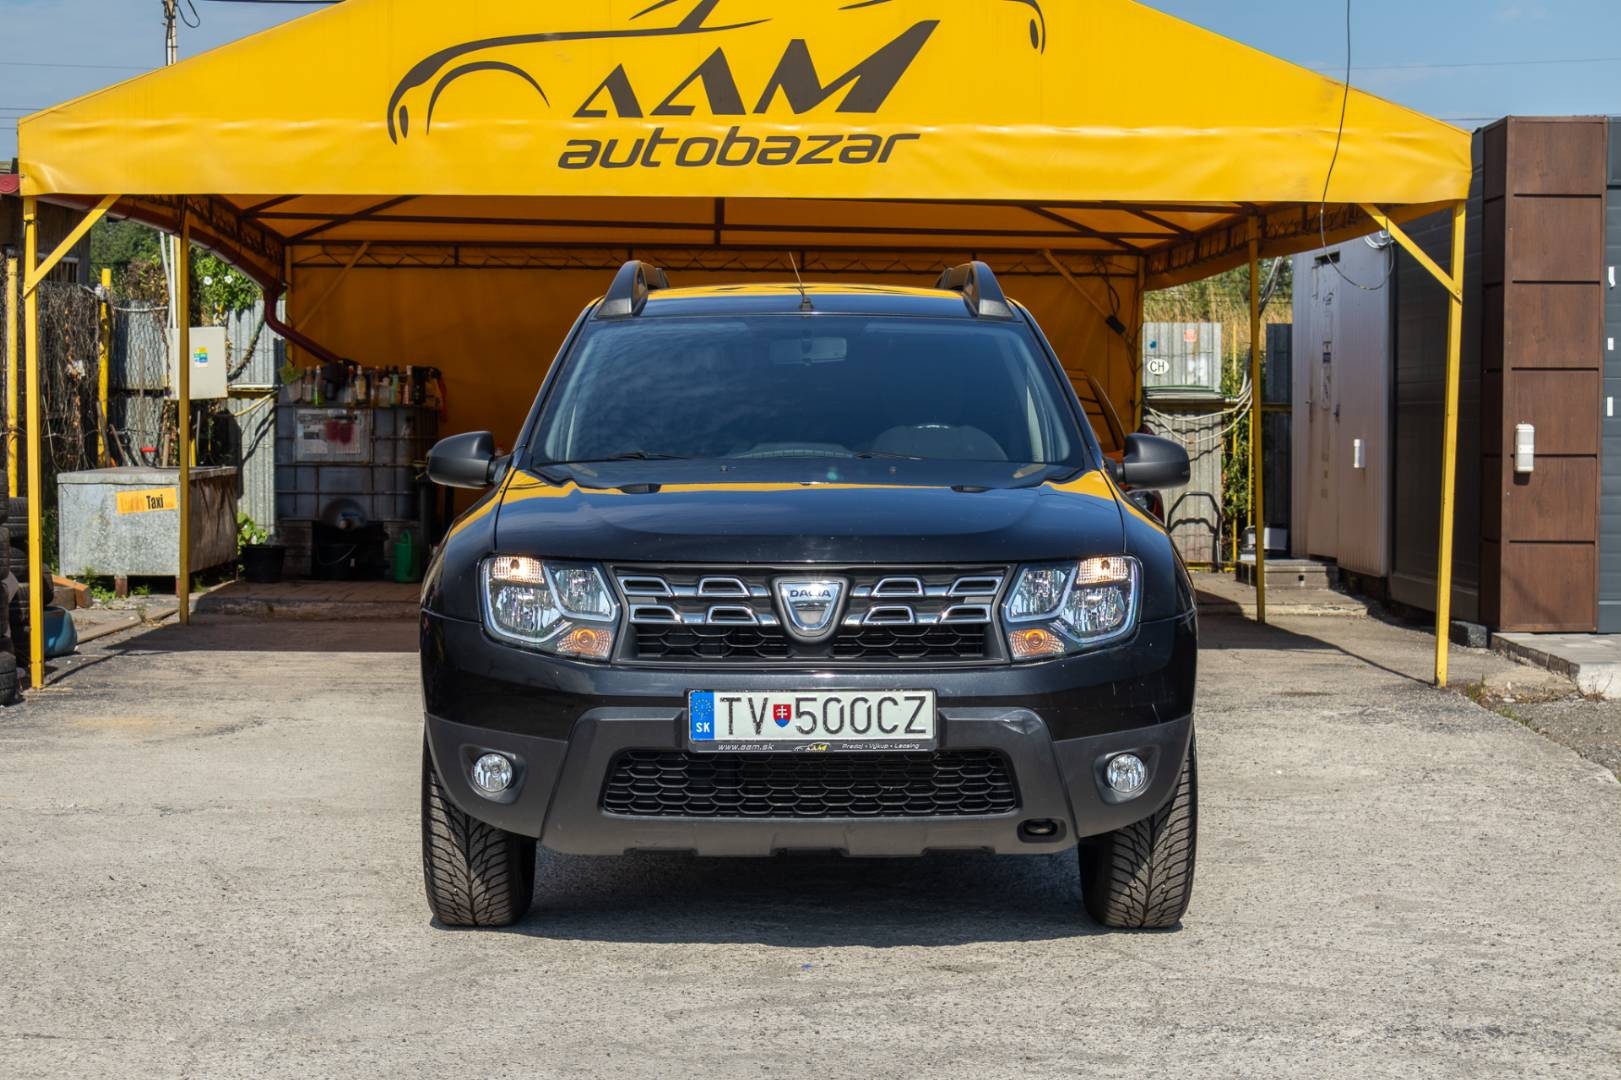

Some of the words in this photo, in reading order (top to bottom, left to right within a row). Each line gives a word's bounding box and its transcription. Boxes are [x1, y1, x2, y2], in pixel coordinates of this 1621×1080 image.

[572, 20, 940, 118] AAM
[558, 126, 920, 169] autobazar
[1149, 361, 1165, 372] CH
[146, 494, 164, 509] Taxi
[695, 722, 711, 734] SK
[719, 696, 768, 735] TV
[794, 695, 927, 735] 500CZ
